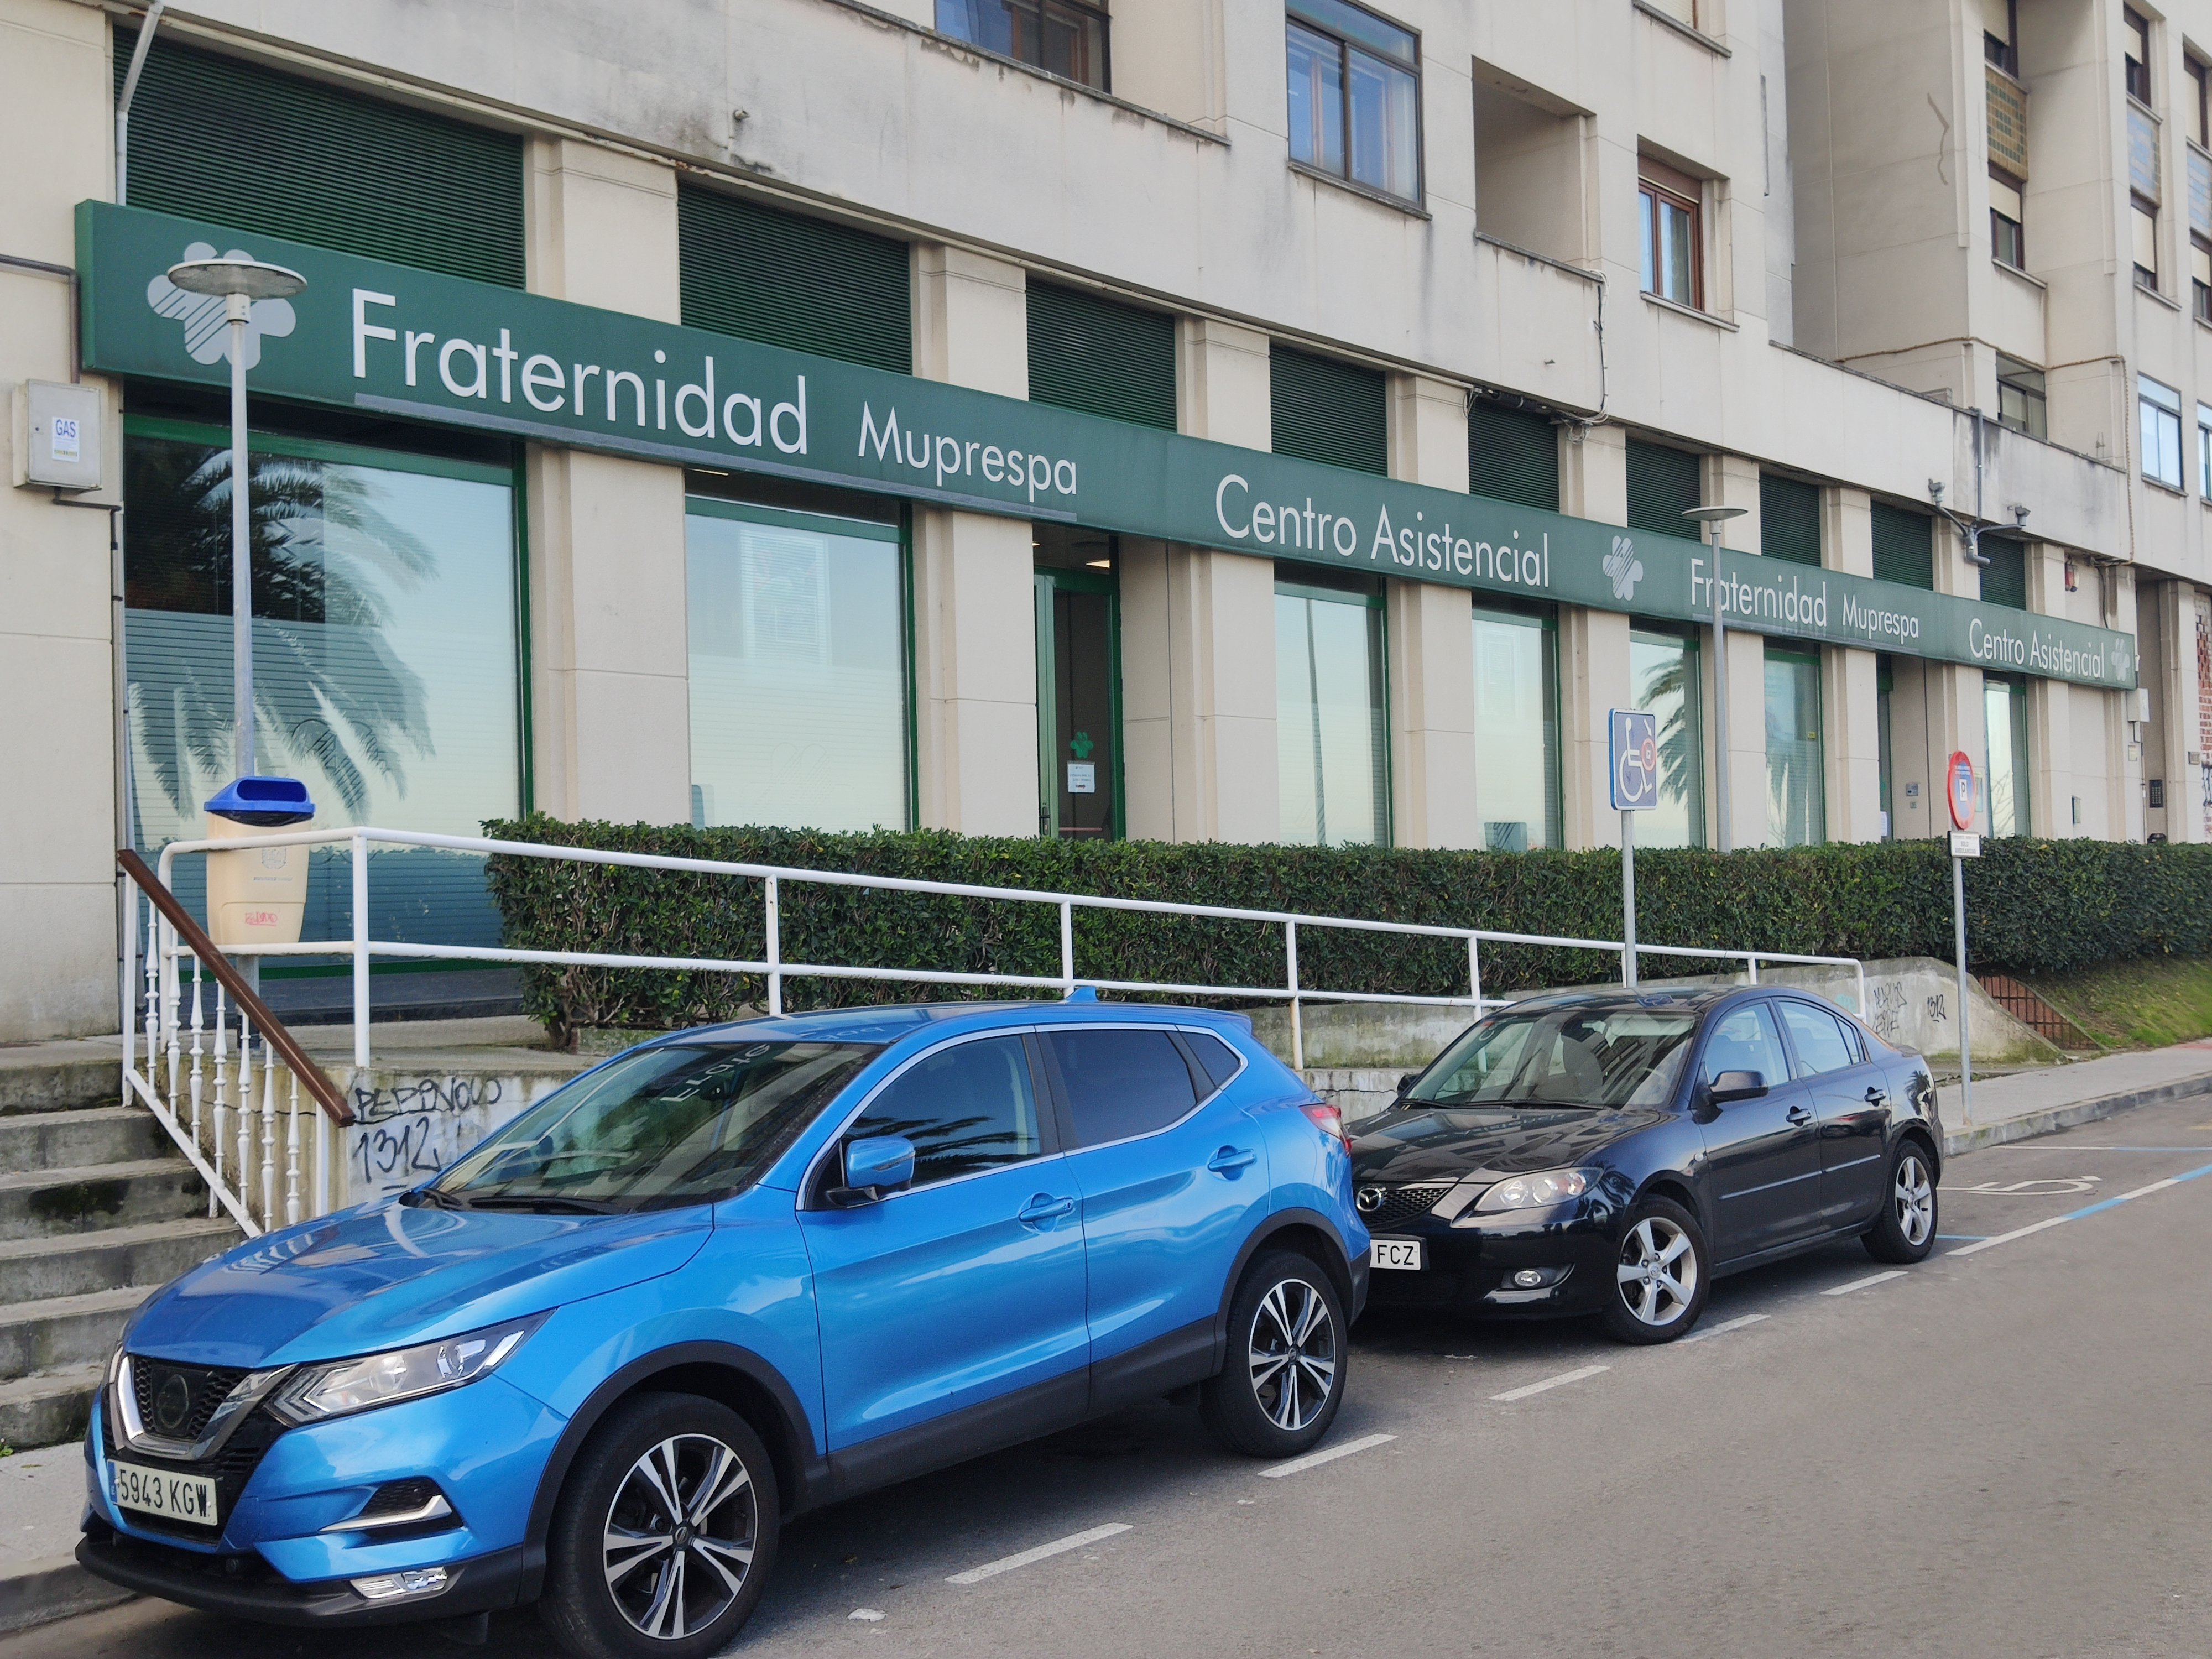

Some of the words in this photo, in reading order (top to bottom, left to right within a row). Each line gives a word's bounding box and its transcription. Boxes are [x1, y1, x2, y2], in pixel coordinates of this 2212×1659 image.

[352, 288, 807, 455] Fraternidad
[858, 400, 1077, 503] Muprespa
[56, 419, 76, 438] GAS
[1215, 474, 1357, 556] Centro
[1370, 504, 1548, 587] Asistencial
[1691, 558, 1827, 627] Fraternidad
[1842, 593, 1919, 645] Muprespa
[1969, 618, 2024, 665] Centro
[2030, 630, 2105, 679] Asistencial
[1961, 782, 1966, 797] P
[352, 1116, 442, 1184] 1312
[1377, 1244, 1414, 1265] FCZ
[119, 1469, 164, 1509] 5943
[169, 1479, 208, 1519] KGW
